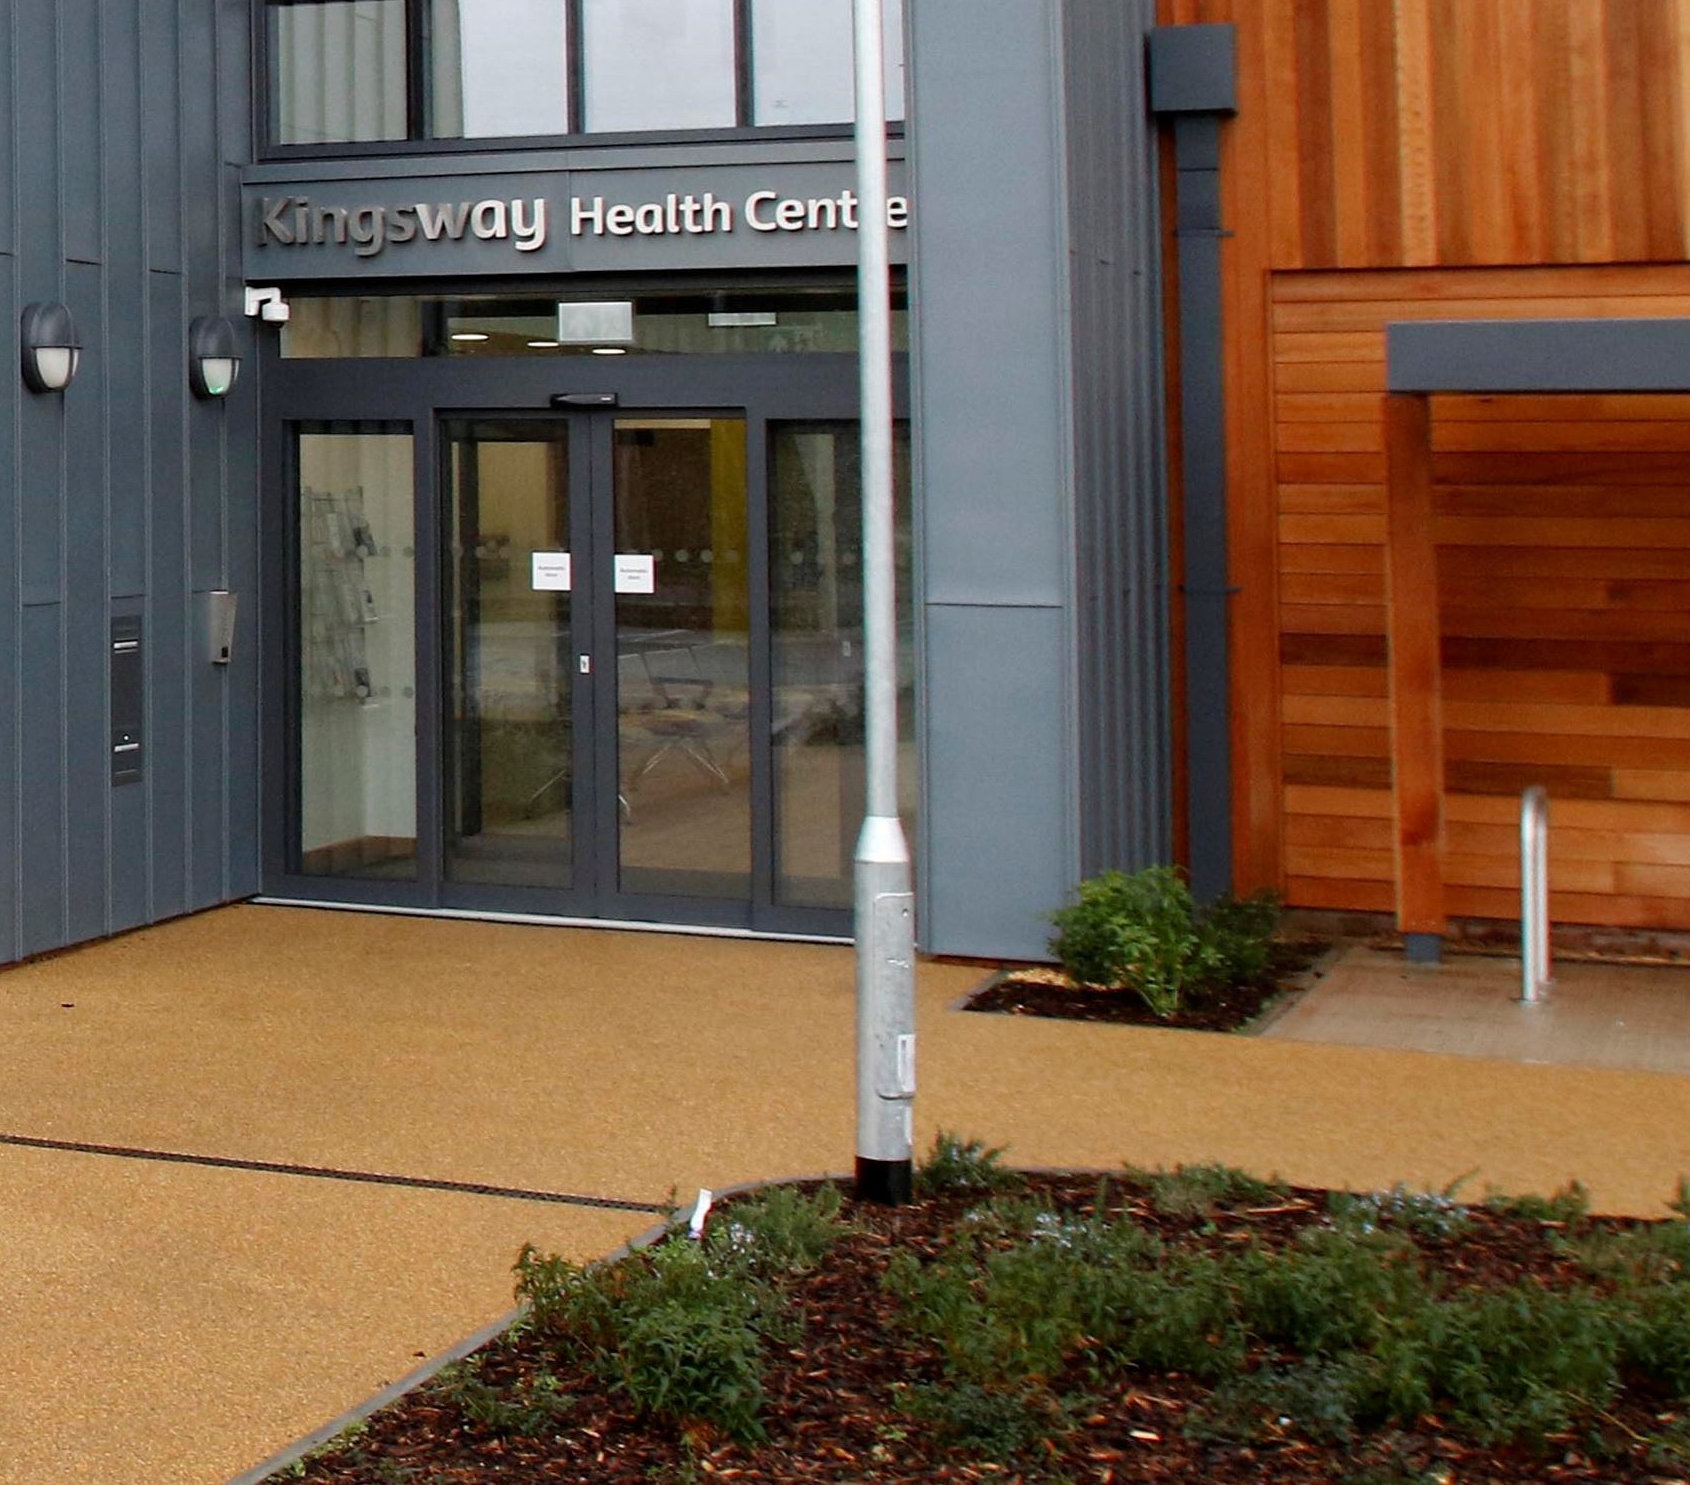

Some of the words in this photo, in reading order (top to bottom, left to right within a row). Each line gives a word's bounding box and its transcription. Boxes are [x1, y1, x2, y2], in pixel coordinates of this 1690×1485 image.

[259, 196, 546, 255] Kingsway
[570, 192, 731, 234] Health
[744, 189, 907, 231] Cente
